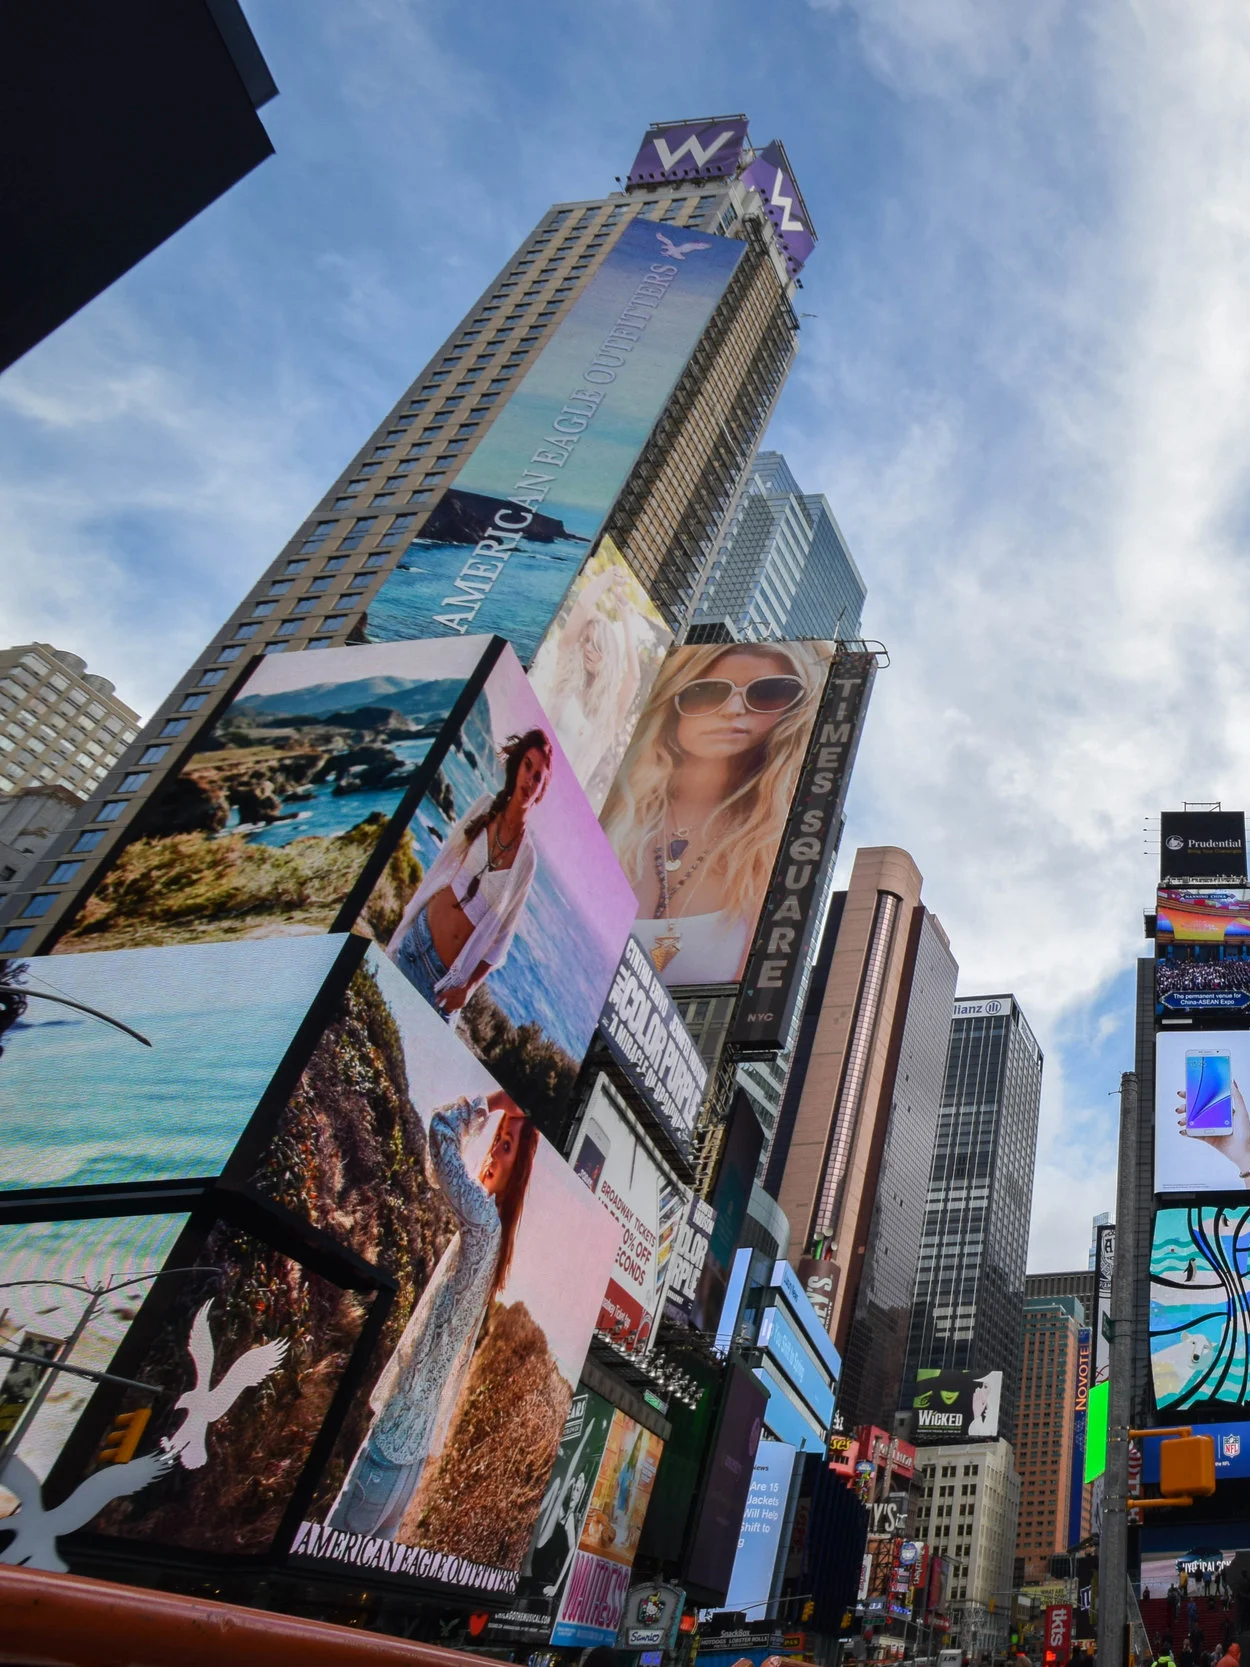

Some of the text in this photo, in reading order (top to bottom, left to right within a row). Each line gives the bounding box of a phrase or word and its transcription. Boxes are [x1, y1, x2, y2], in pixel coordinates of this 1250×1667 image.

[653, 131, 734, 171] W
[433, 262, 678, 634] AMERICAN EAGLE OUTFITTERS
[757, 679, 861, 989] TIMES SQUARE
[1188, 839, 1242, 848] Prudential
[747, 1012, 774, 1022] NYC
[953, 1005, 983, 1015] lianz
[620, 974, 668, 1067] COLOR
[660, 1038, 704, 1132] PURPLE
[601, 1180, 656, 1248] BROADWAY TICKETS
[622, 1227, 652, 1265] 0% OFF
[1225, 1444, 1239, 1454] NFL
[750, 1482, 779, 1492] Are 15
[746, 1494, 779, 1506] Jackets
[762, 1509, 779, 1520] Help
[740, 1522, 770, 1533] Shift to
[288, 1521, 520, 1595] AMERICAN EAGLE OUTFITTERS
[1050, 1608, 1067, 1647] tkts
